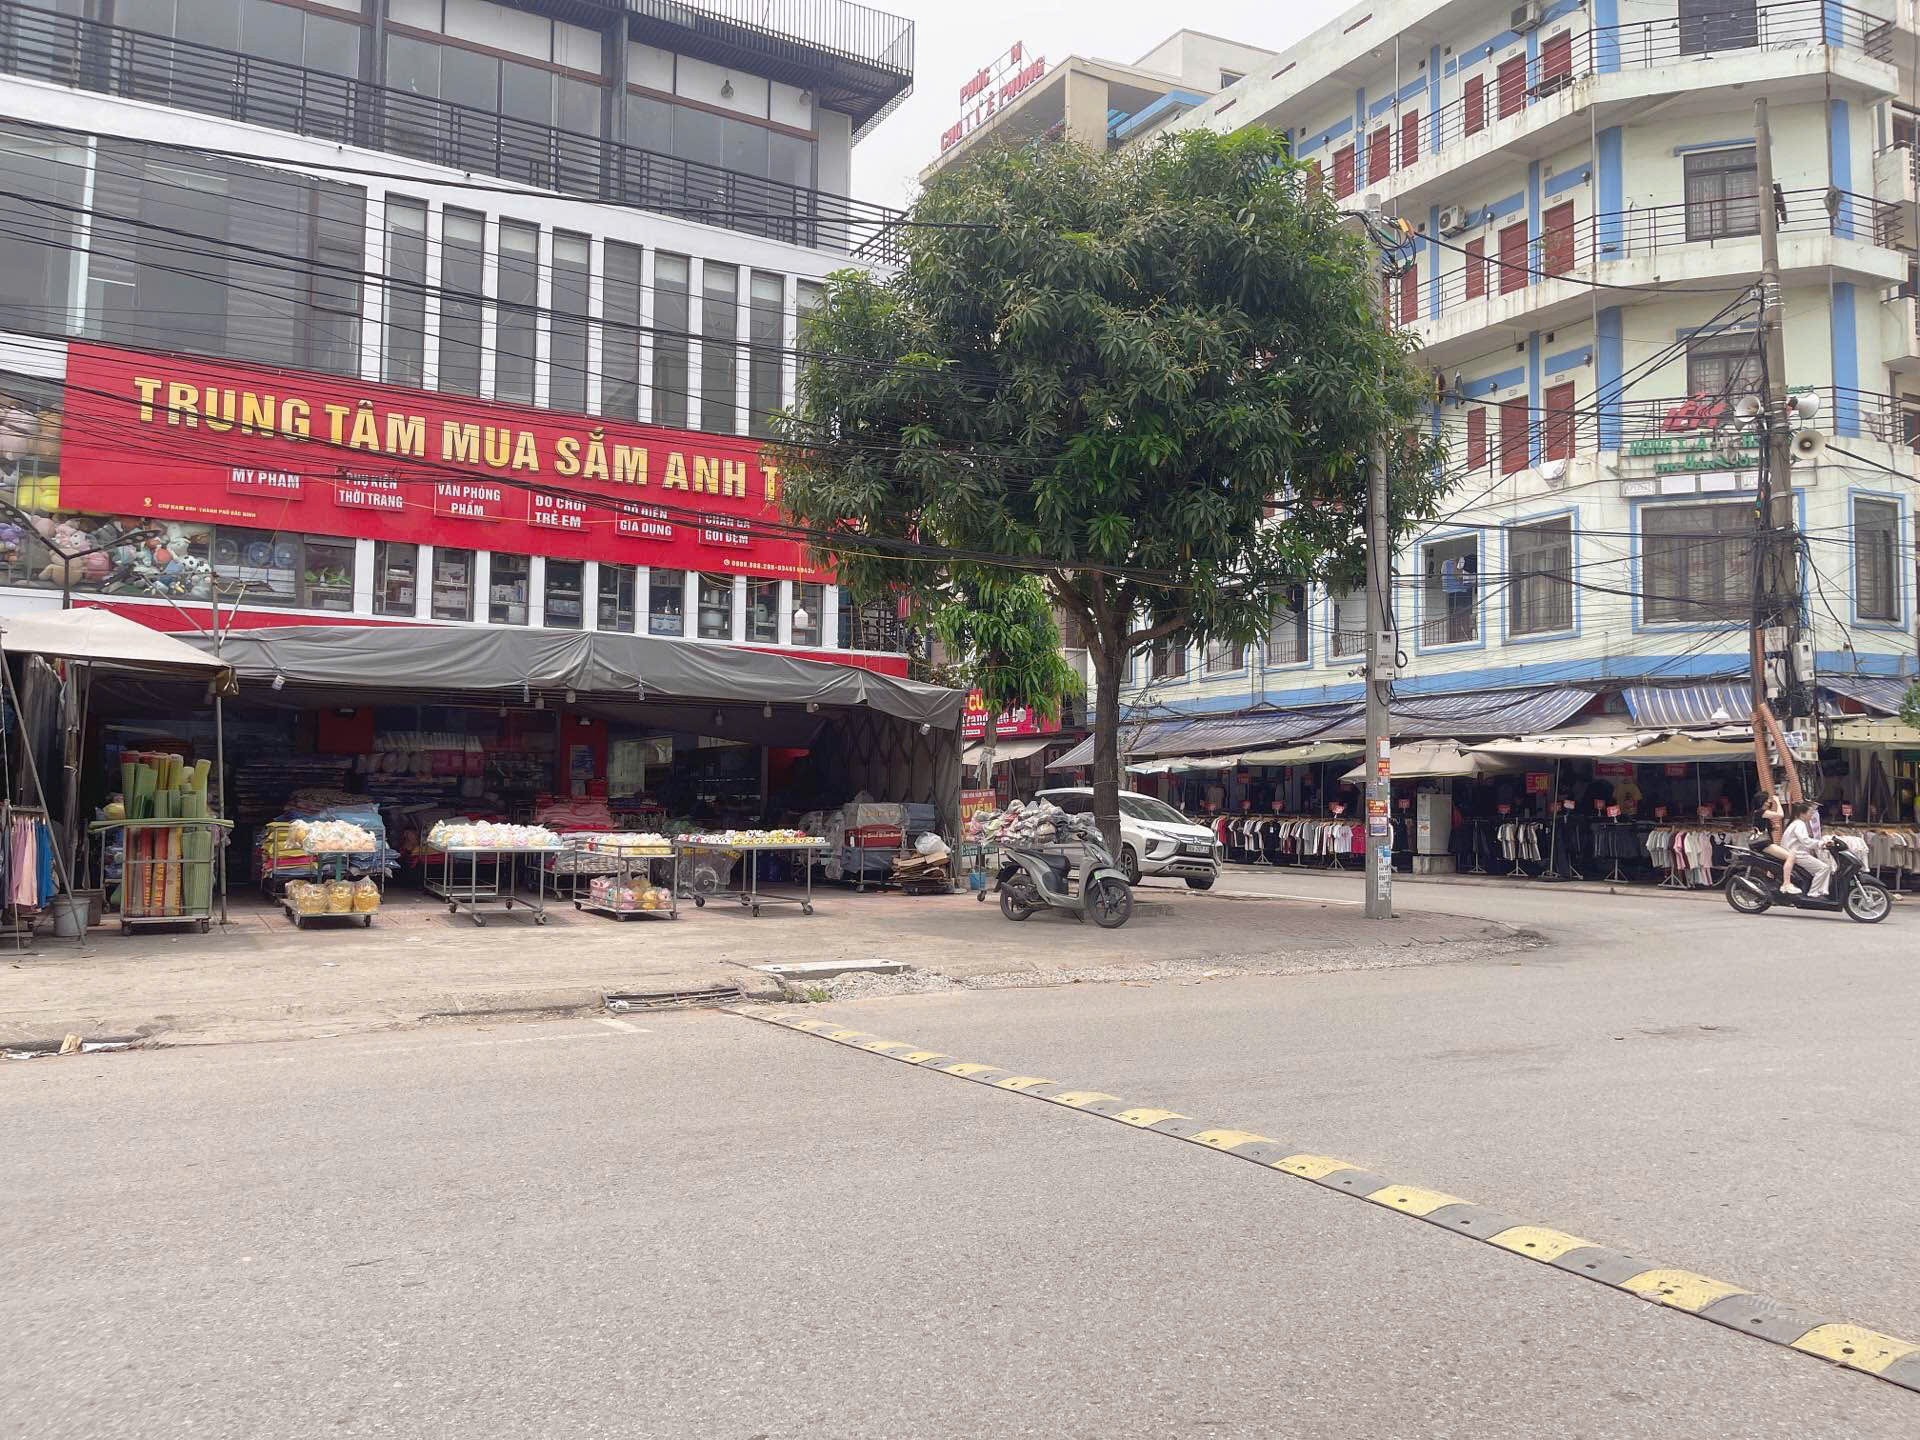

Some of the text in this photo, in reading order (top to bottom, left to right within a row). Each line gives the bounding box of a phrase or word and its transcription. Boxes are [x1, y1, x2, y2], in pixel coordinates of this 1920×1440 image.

[134, 376, 311, 442] TRUNG
[325, 399, 425, 457] TÂM
[442, 420, 539, 472] MUA
[662, 451, 746, 498] ANH
[367, 493, 403, 509] TRANG
[561, 514, 582, 528] EM
[620, 520, 639, 532] GIA
